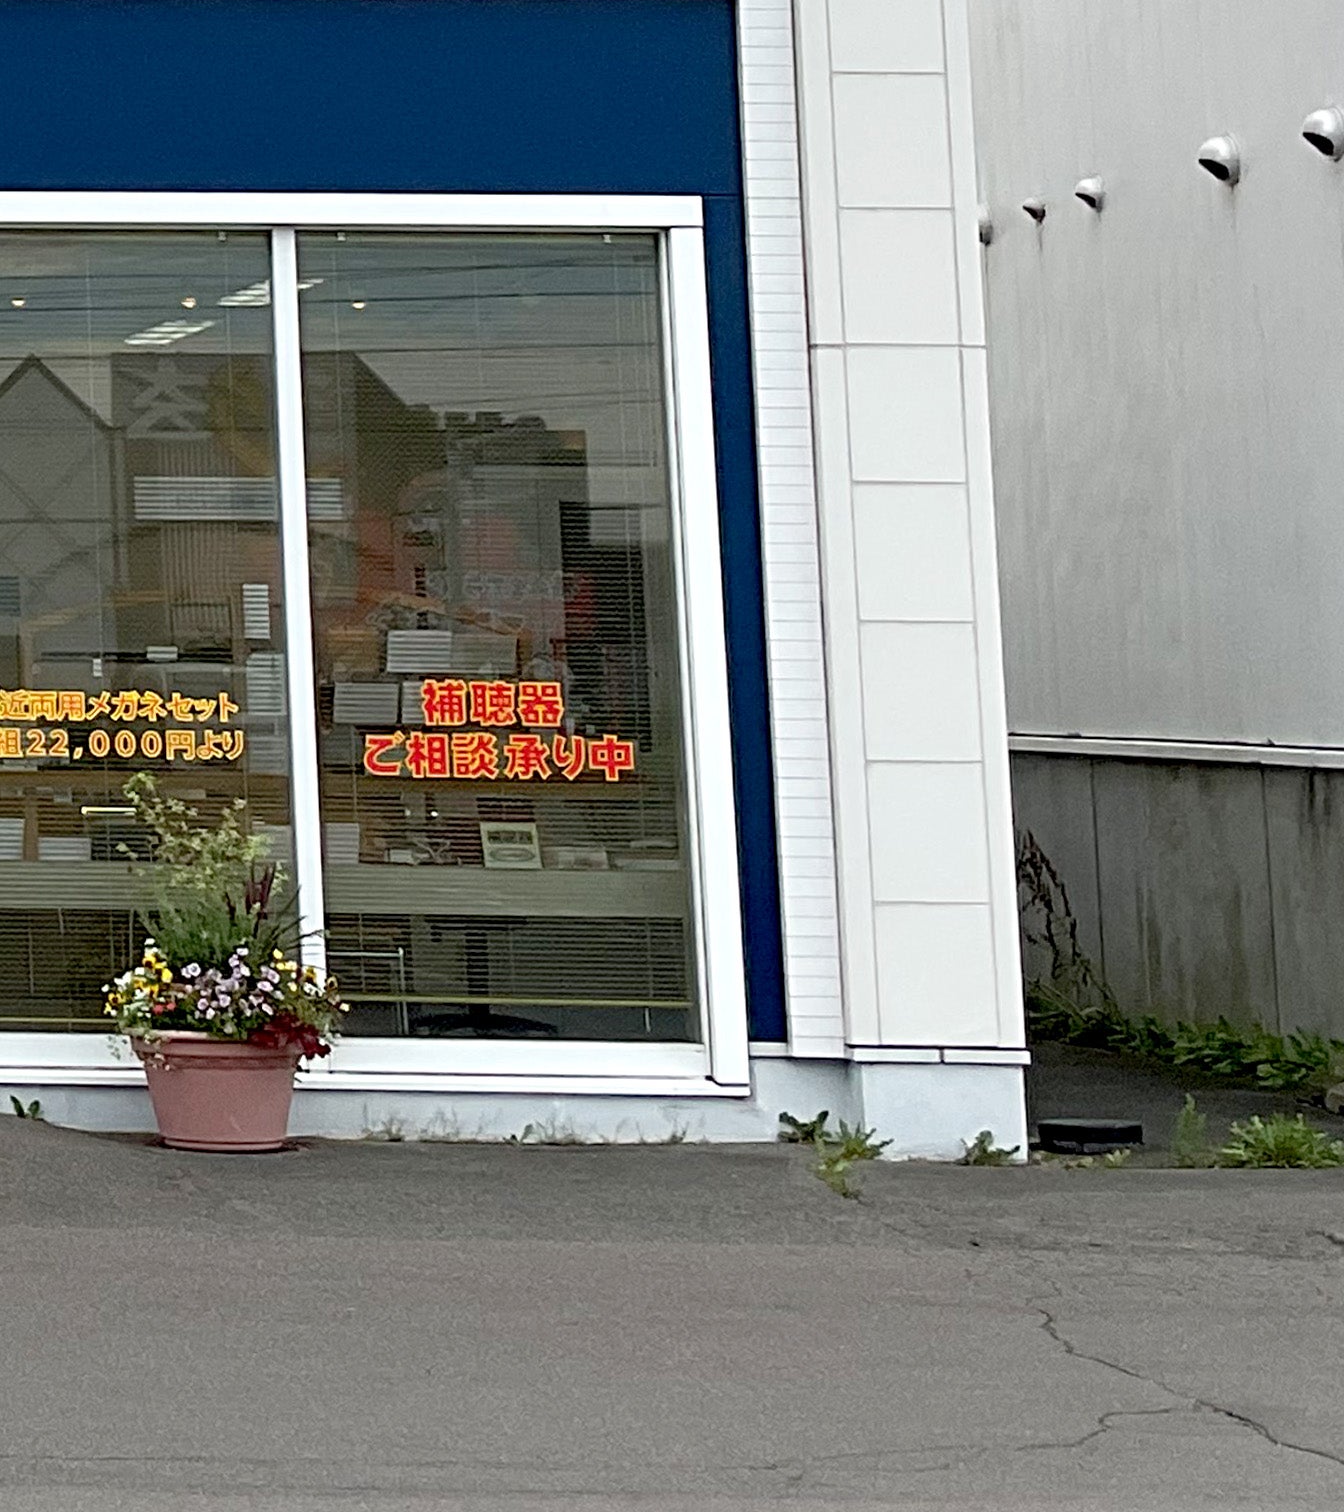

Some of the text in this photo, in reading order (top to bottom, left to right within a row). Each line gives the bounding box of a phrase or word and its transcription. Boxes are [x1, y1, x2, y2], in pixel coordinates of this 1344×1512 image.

[420, 678, 565, 728] 補聴器
[363, 730, 635, 783] ご相談承り中
